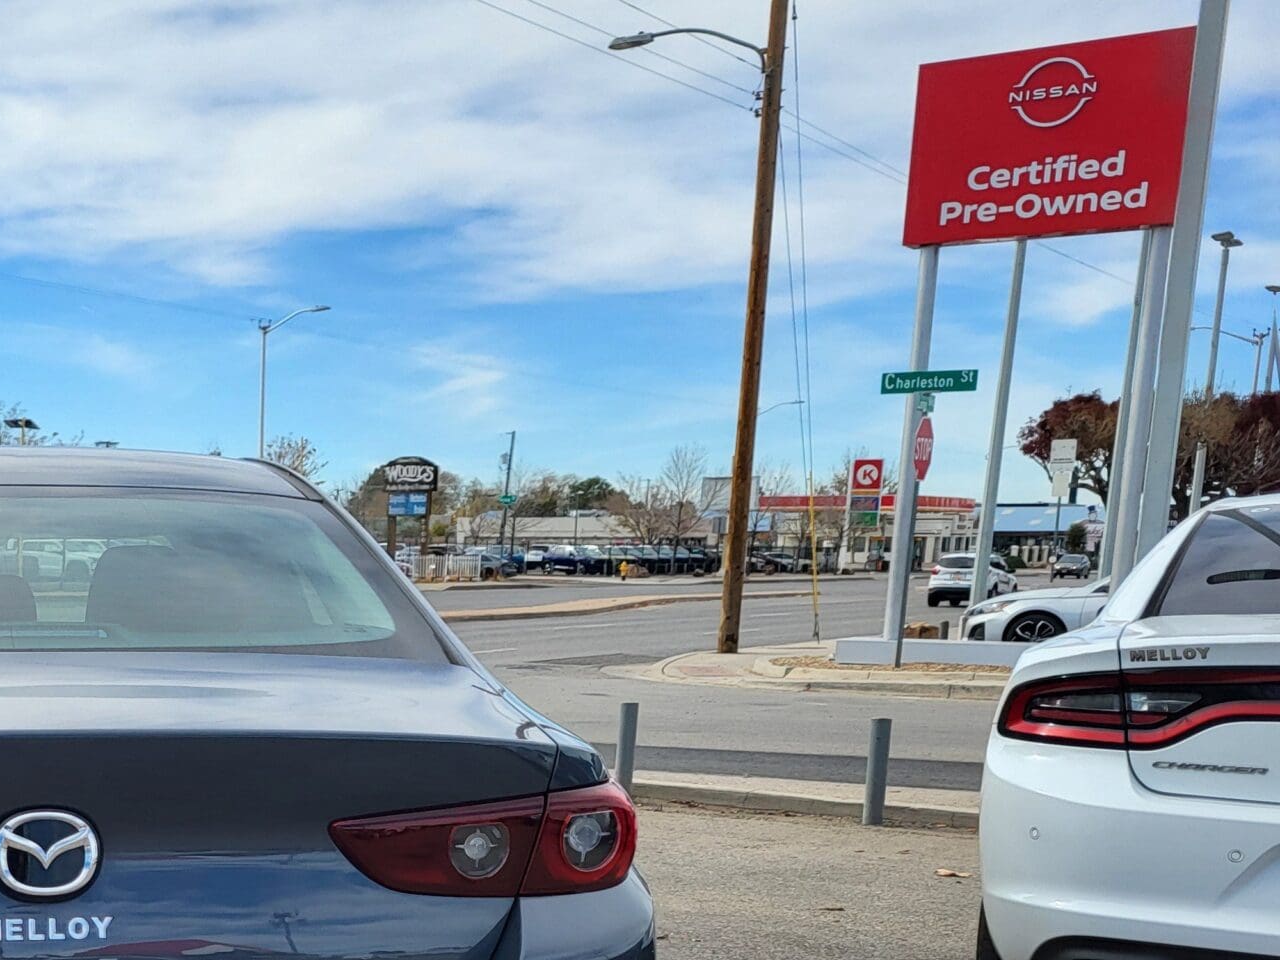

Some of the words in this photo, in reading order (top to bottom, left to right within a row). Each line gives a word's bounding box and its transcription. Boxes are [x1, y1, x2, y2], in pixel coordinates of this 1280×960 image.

[1008, 81, 1098, 104] NISSAN
[967, 150, 1126, 191] Certified
[939, 181, 1149, 226] Pre-Owned
[885, 373, 954, 390] Charleston
[961, 370, 974, 383] St
[915, 437, 933, 461] STOP
[1130, 647, 1210, 662] MELLOY
[1152, 760, 1269, 775] CHARGER
